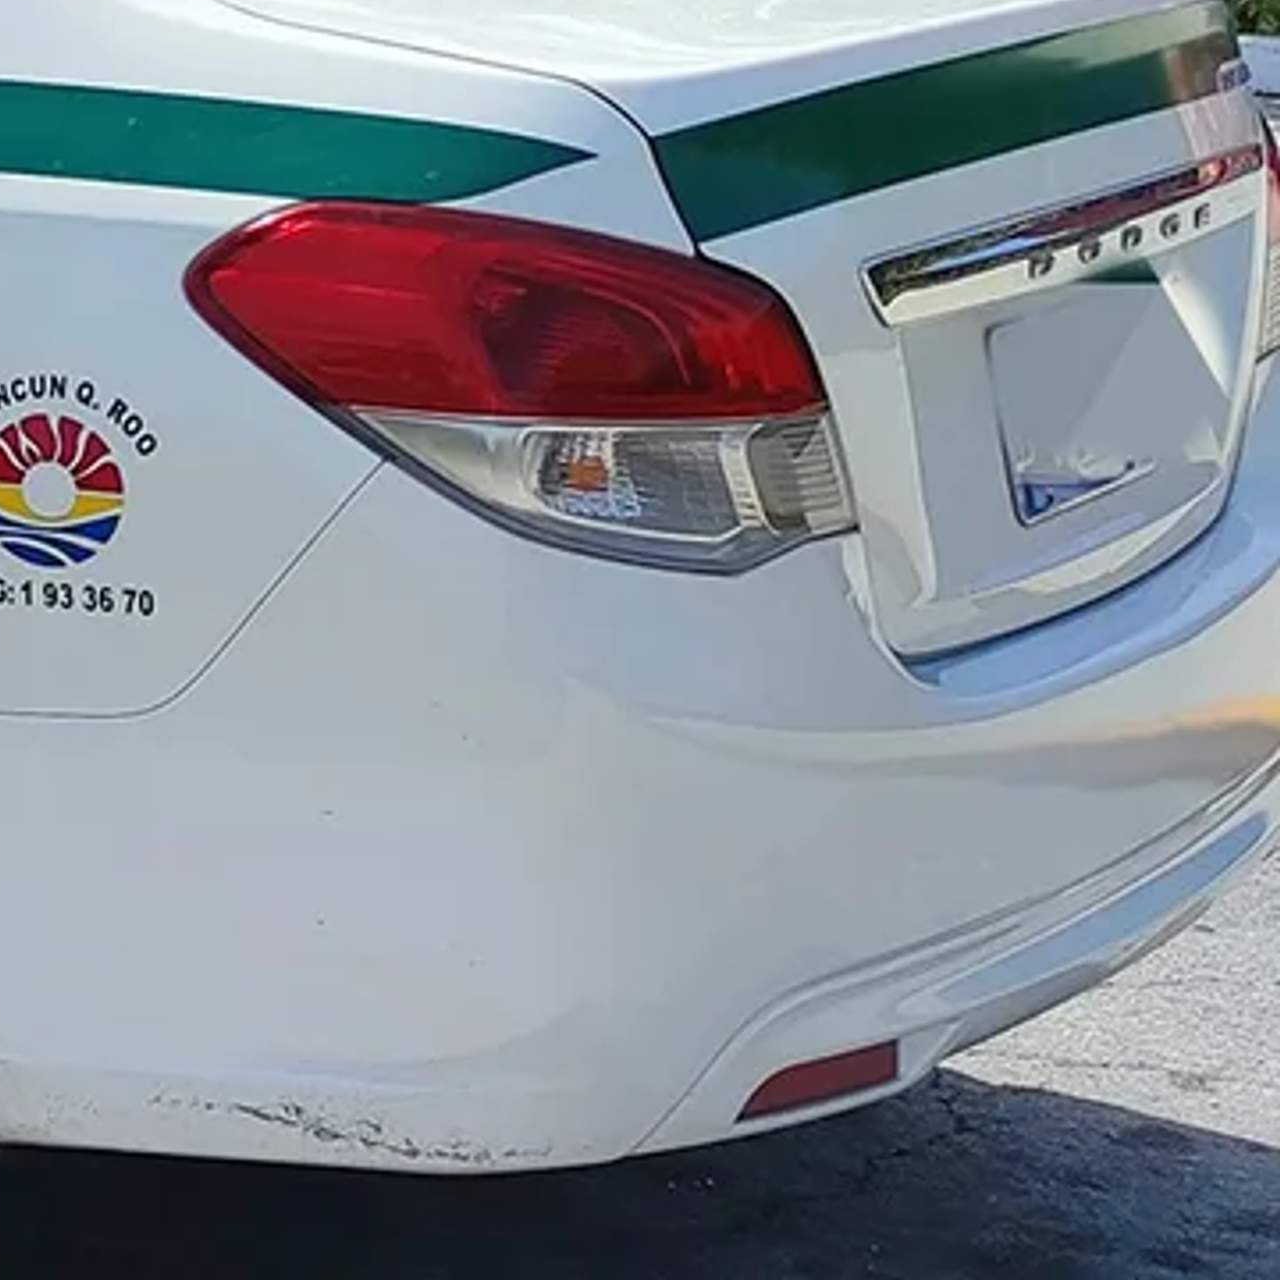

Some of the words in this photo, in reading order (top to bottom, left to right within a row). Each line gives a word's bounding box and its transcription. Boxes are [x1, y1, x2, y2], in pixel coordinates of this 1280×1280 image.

[1027, 203, 1213, 279] DODGE
[76, 382, 100, 409] Q.
[107, 399, 158, 456] ROO
[42, 582, 74, 609] 93
[82, 585, 115, 613] 36
[123, 588, 155, 616] 70
